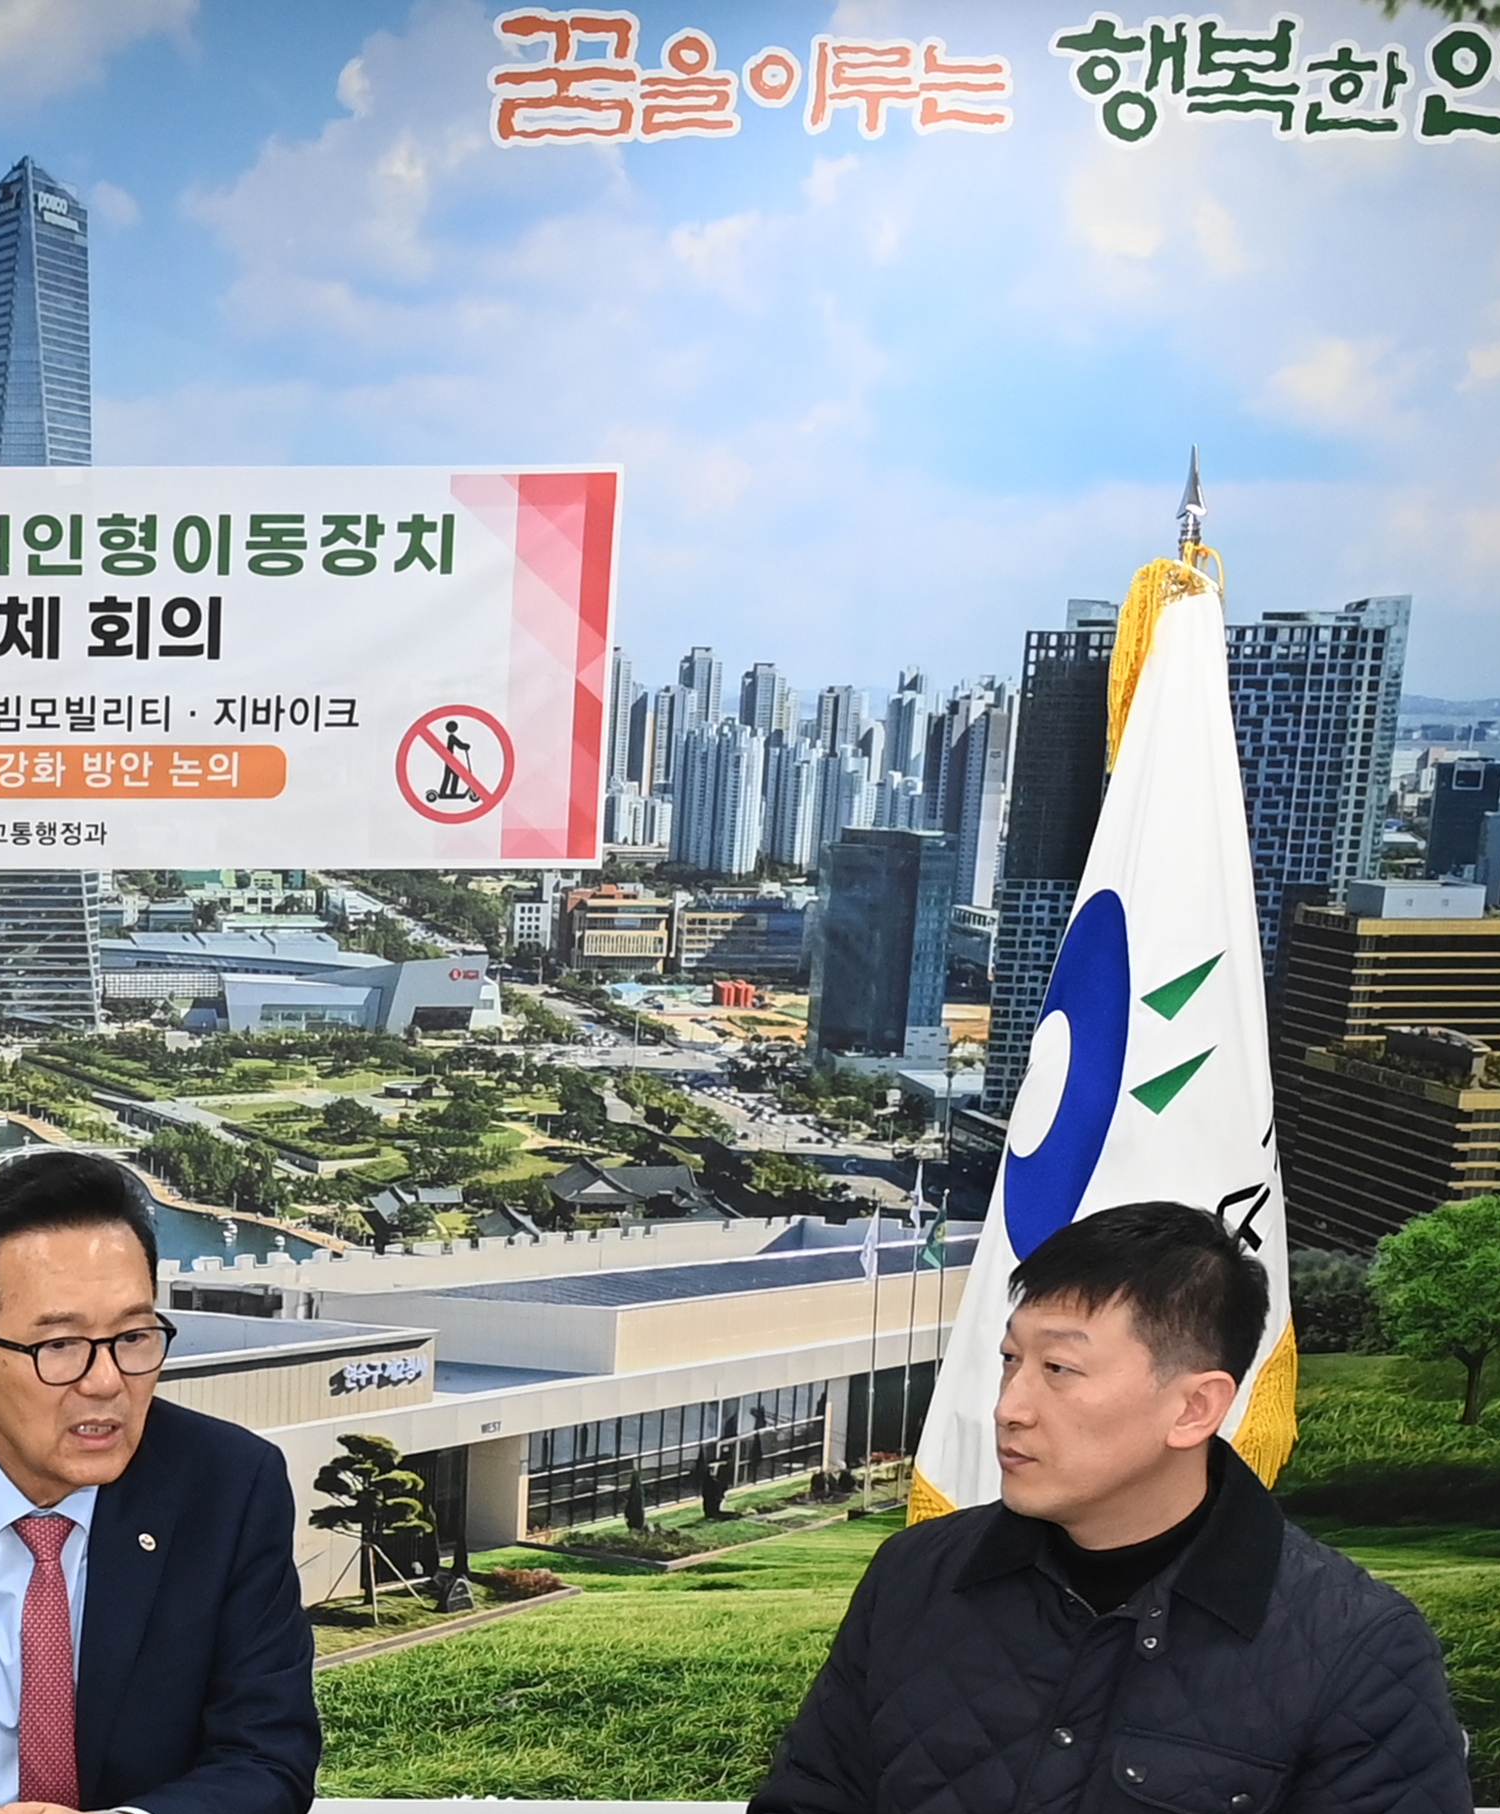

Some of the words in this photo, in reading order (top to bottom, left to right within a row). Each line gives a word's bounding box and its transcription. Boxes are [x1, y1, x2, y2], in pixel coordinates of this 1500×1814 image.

[494, 13, 734, 140] 꿈을
[748, 36, 1008, 136] 이루는
[1056, 14, 1410, 143] 행복한
[87, 596, 222, 660] 회의
[214, 695, 359, 733] 지바이크
[84, 752, 153, 787] 방안
[169, 752, 238, 787] 논의
